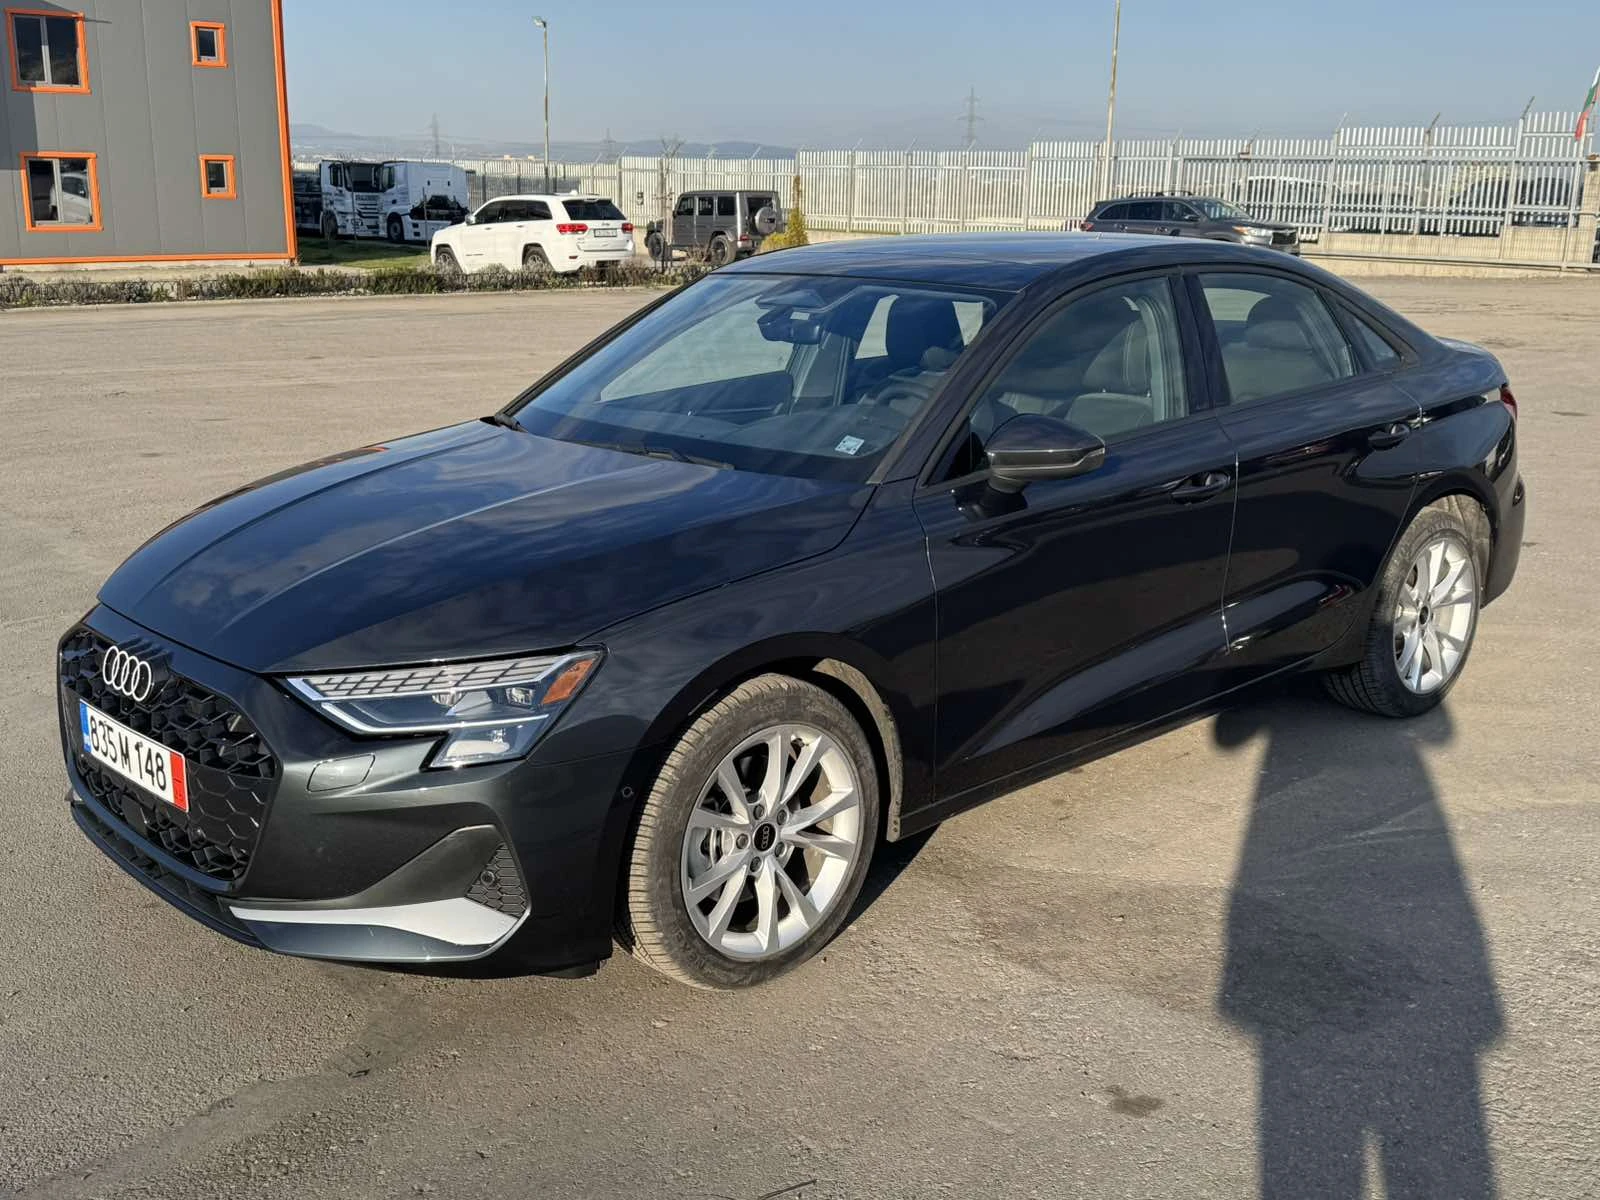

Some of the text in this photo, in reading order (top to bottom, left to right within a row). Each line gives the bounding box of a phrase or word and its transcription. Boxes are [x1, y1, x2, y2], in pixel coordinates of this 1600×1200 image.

[90, 715, 118, 763] 835
[118, 731, 132, 773] M
[134, 741, 167, 791] 148
